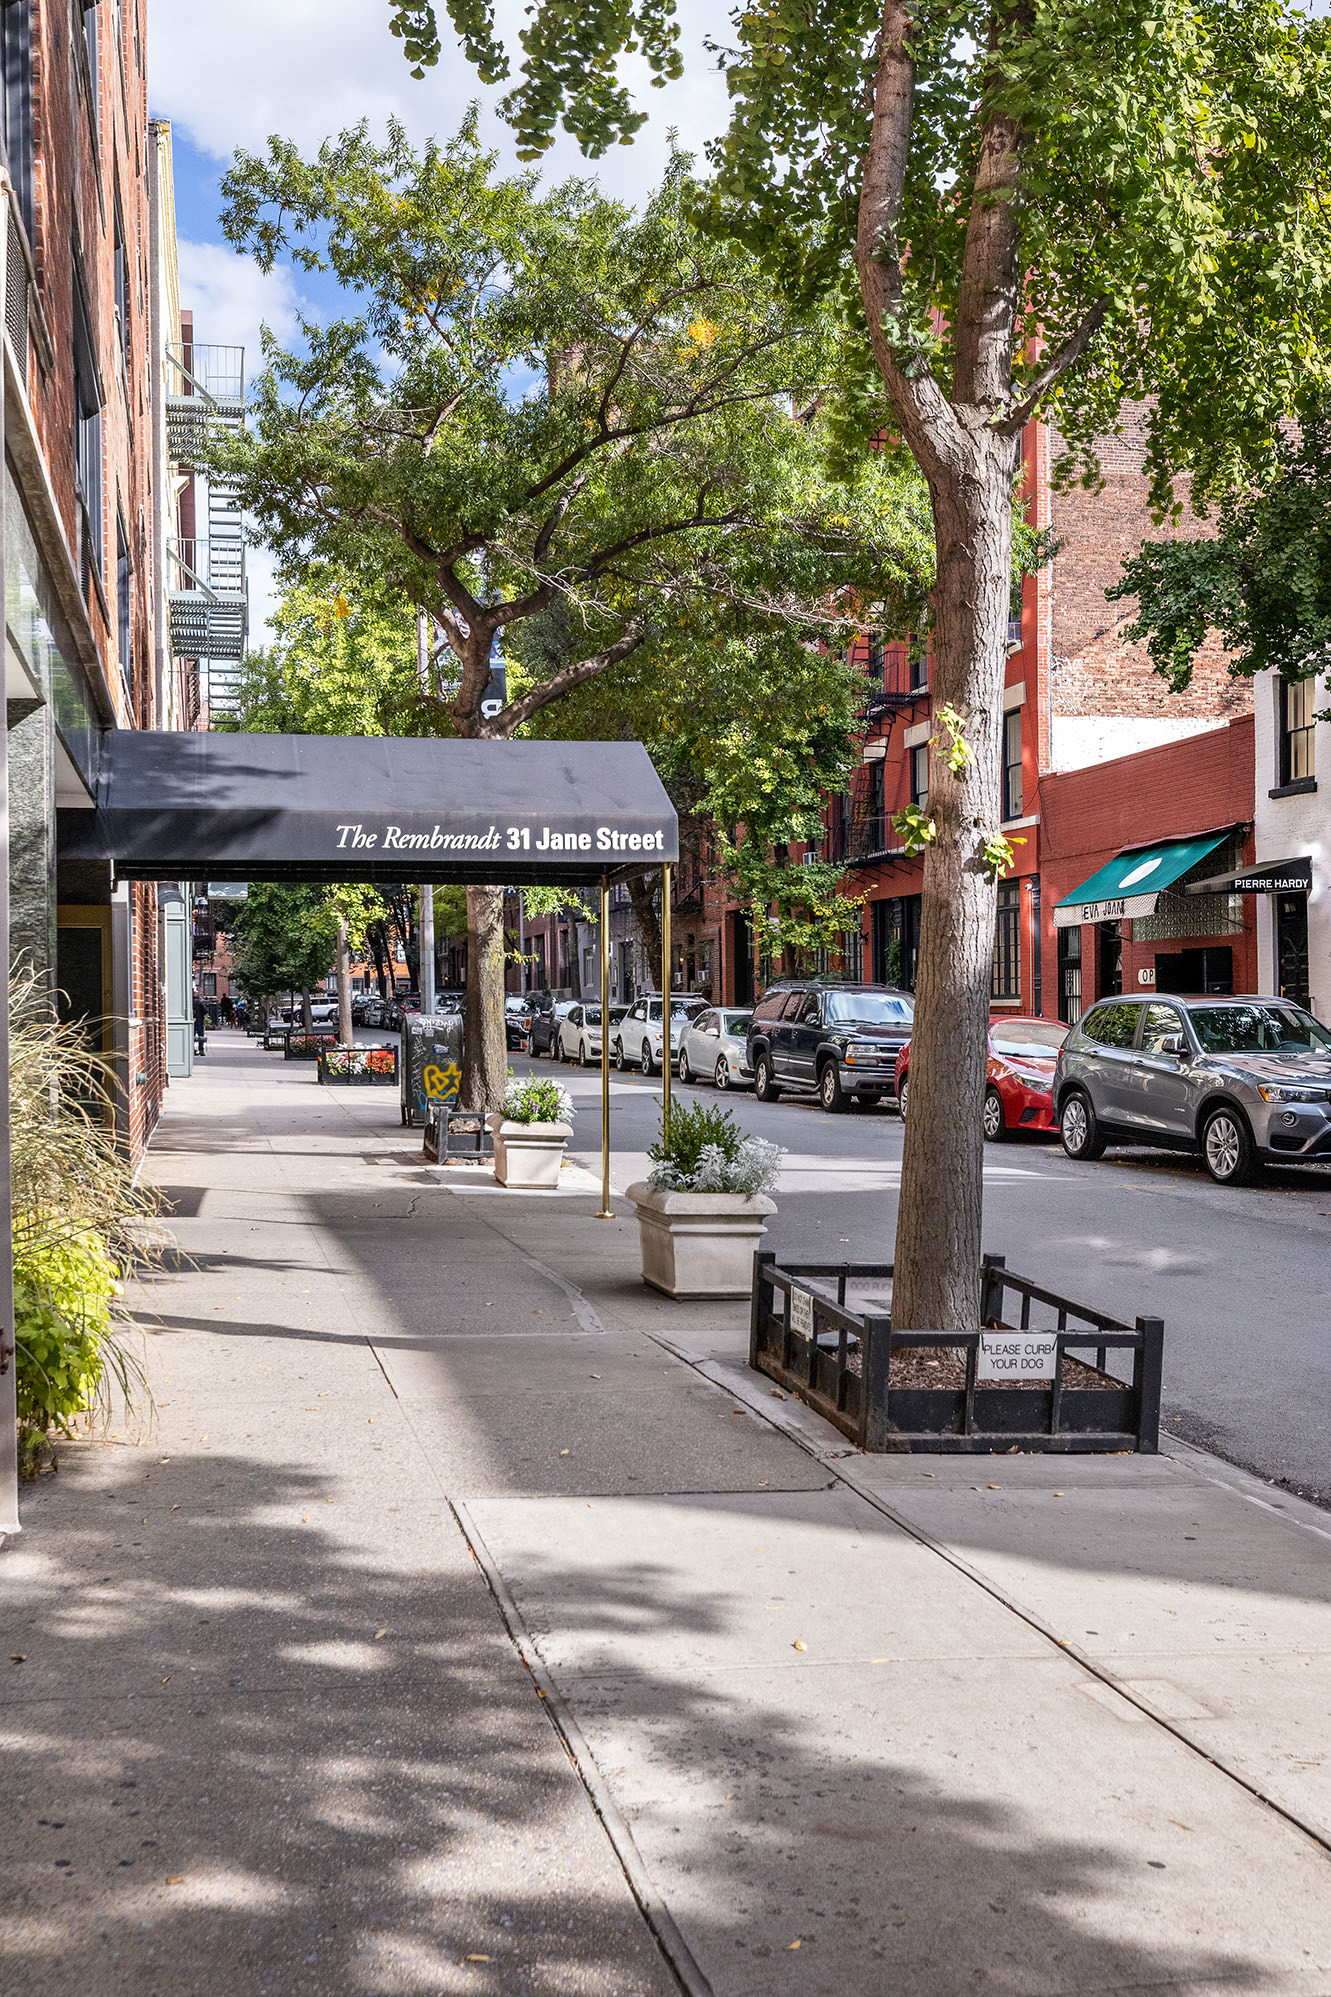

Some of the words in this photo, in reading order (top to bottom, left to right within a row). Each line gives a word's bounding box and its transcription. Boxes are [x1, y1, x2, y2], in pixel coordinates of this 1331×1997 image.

[336, 824, 378, 849] The
[381, 825, 503, 850] Rembrandt
[506, 827, 531, 850] 31
[536, 827, 592, 850] Jane
[596, 827, 665, 850] Street
[1234, 879, 1273, 889] PIERRE
[1274, 879, 1309, 889] HARDY
[1083, 903, 1100, 920] EVA
[983, 1344, 1021, 1355] PLEASE
[1024, 1344, 1052, 1355] CURB
[990, 1359, 1018, 1369] YOUR
[1021, 1359, 1044, 1369] DOG
